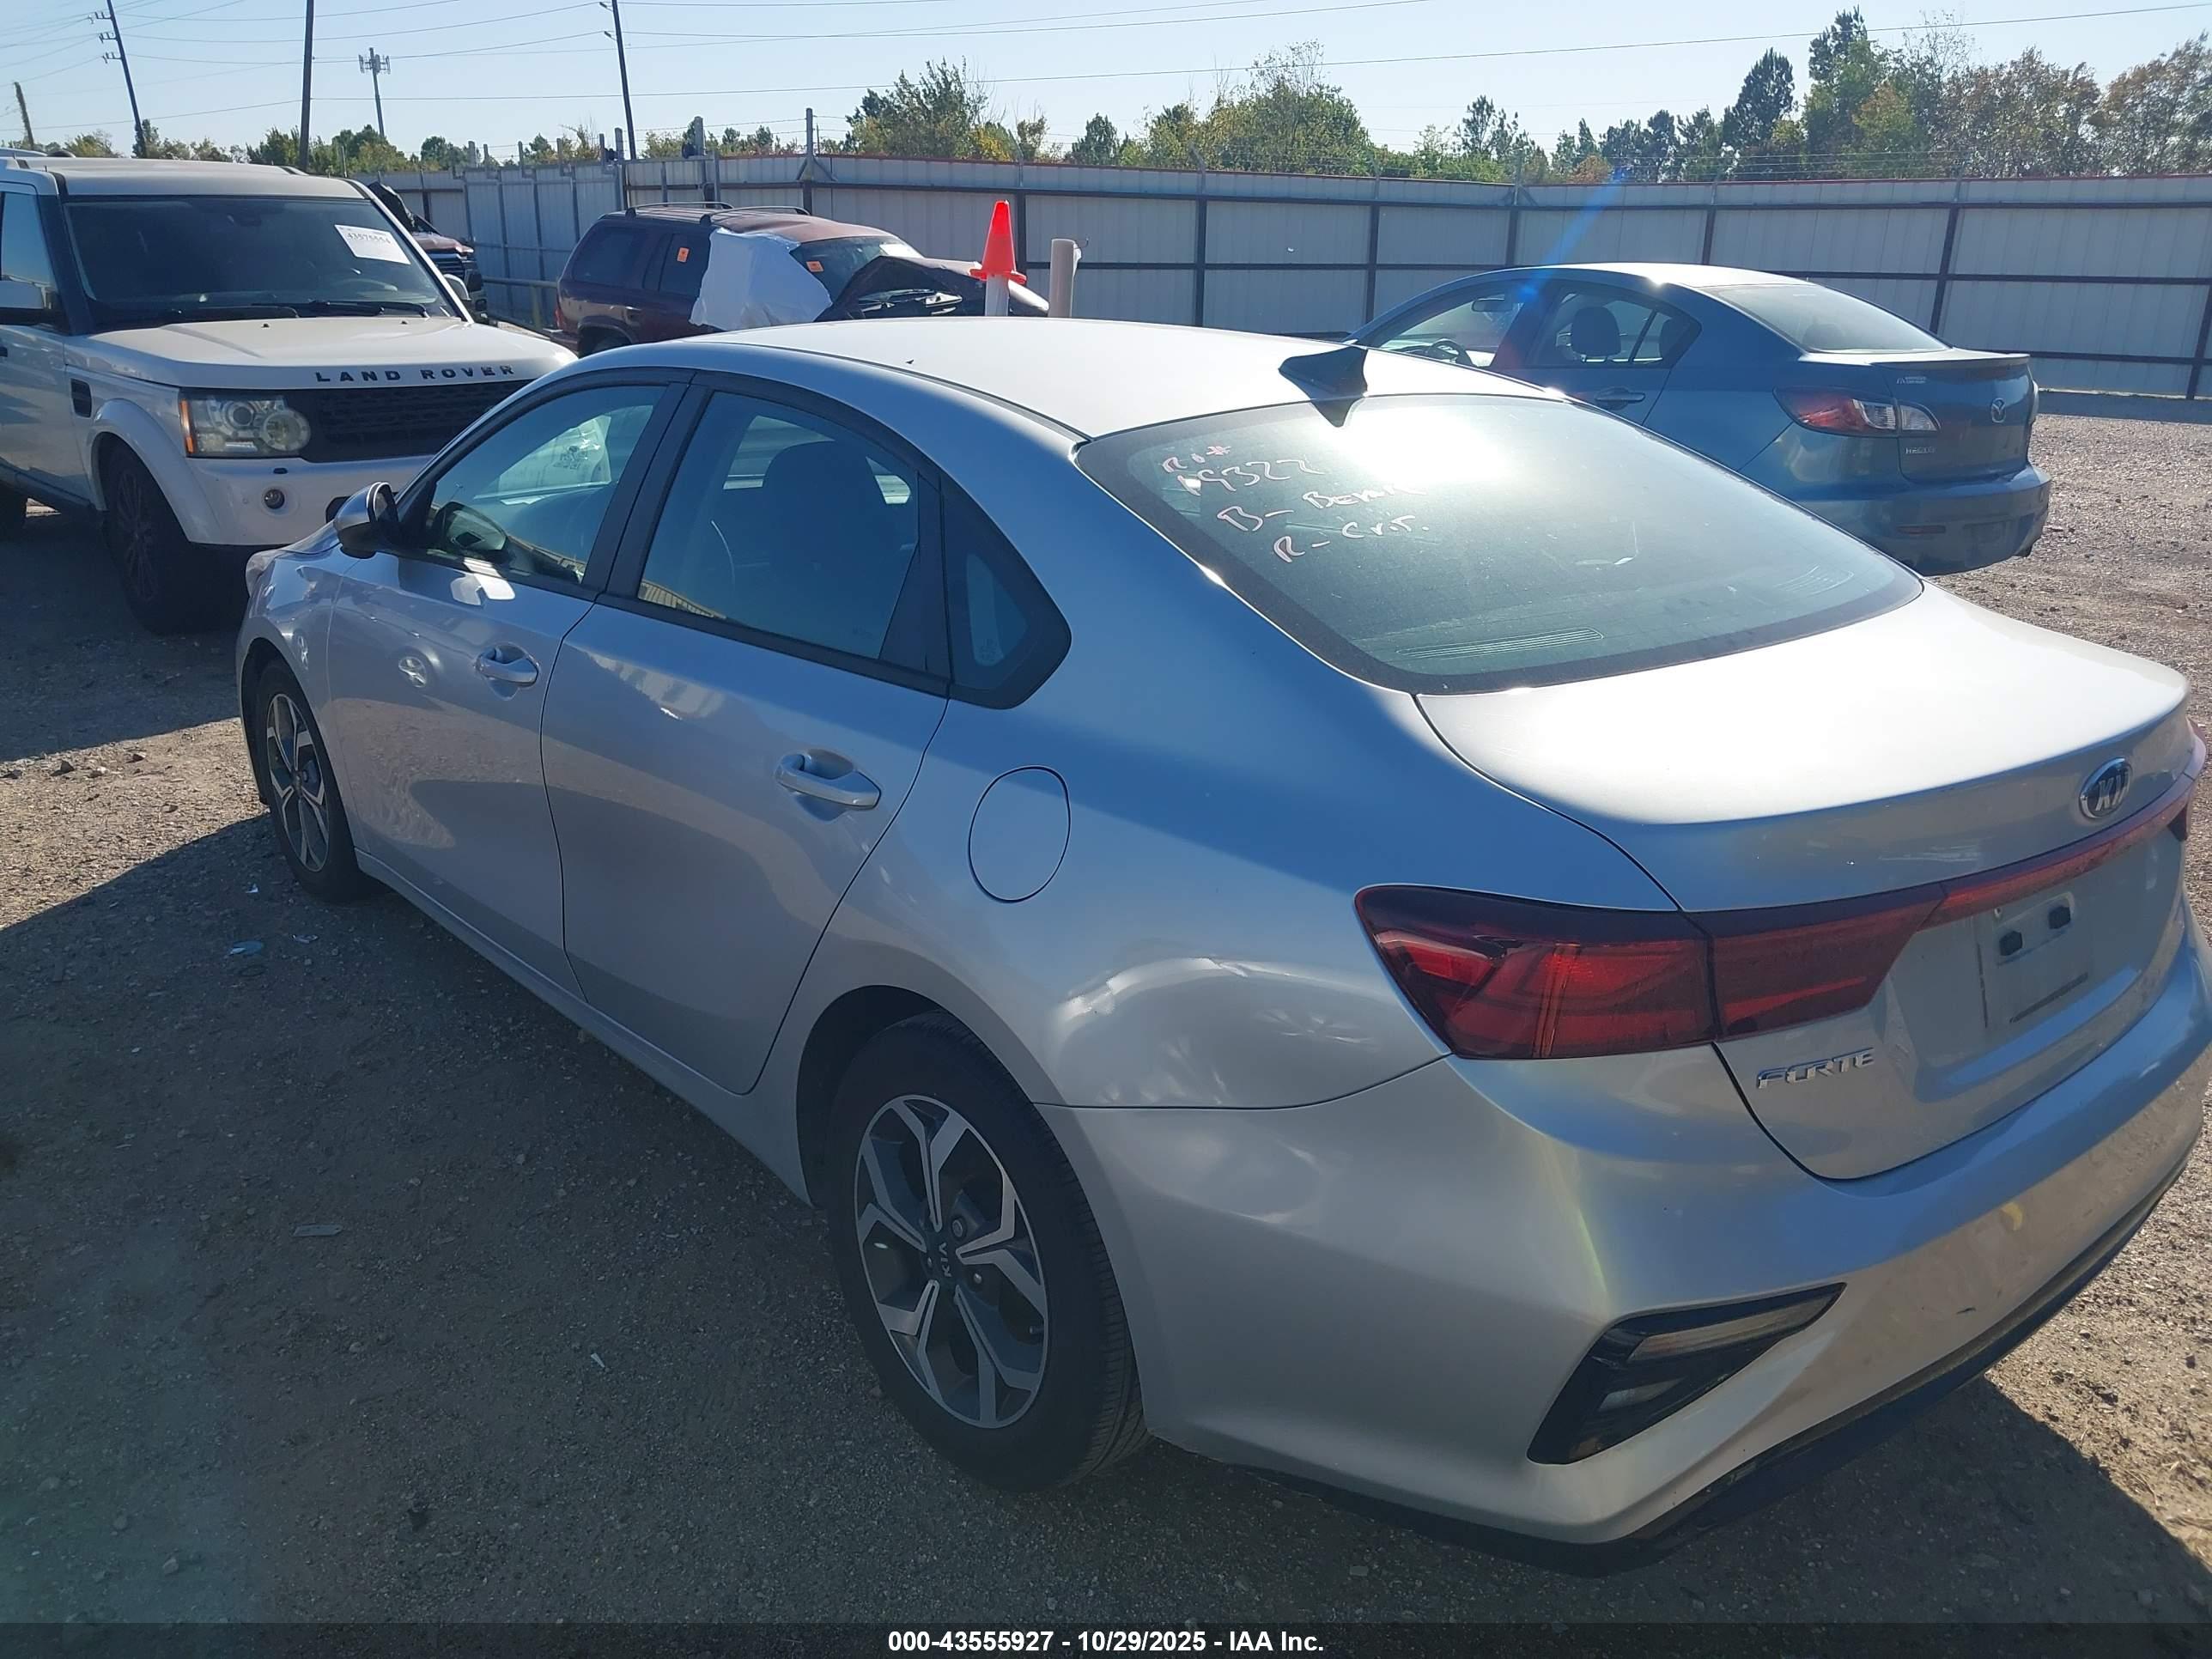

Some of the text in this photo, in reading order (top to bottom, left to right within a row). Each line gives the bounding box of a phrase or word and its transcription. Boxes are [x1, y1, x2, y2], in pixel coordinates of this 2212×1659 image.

[315, 365, 514, 382] LAND ROVER
[1757, 1047, 1875, 1089] FORTE
[939, 1242, 952, 1278] KIA
